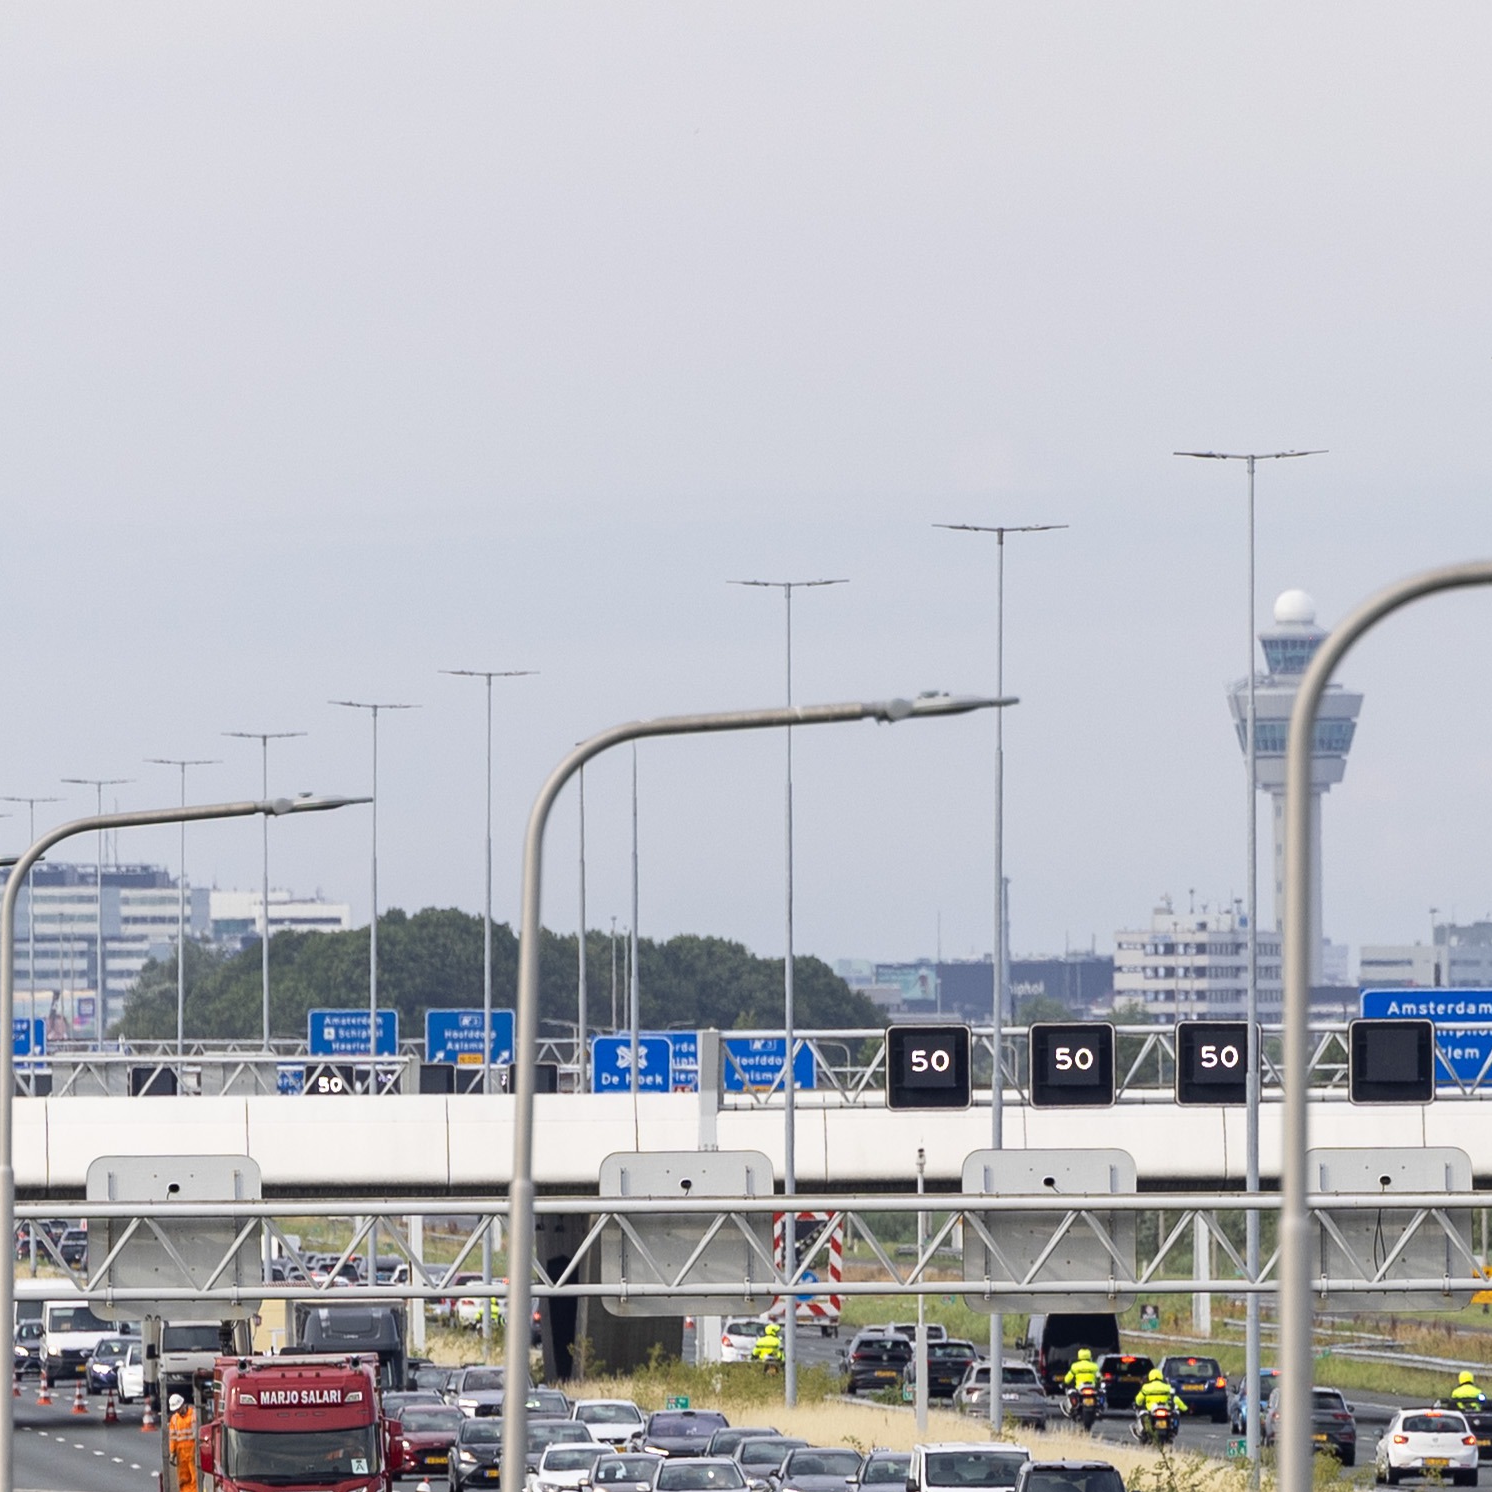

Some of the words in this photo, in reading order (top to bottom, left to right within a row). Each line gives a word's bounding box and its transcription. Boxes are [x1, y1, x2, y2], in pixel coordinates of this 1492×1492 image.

[911, 1050, 950, 1072] 50
[1055, 1047, 1094, 1070] 50
[1201, 1045, 1239, 1069] 50
[317, 1076, 344, 1093] 50
[601, 1073, 619, 1085] De
[260, 1391, 299, 1405] MARJO
[301, 1390, 341, 1404] SALARI
